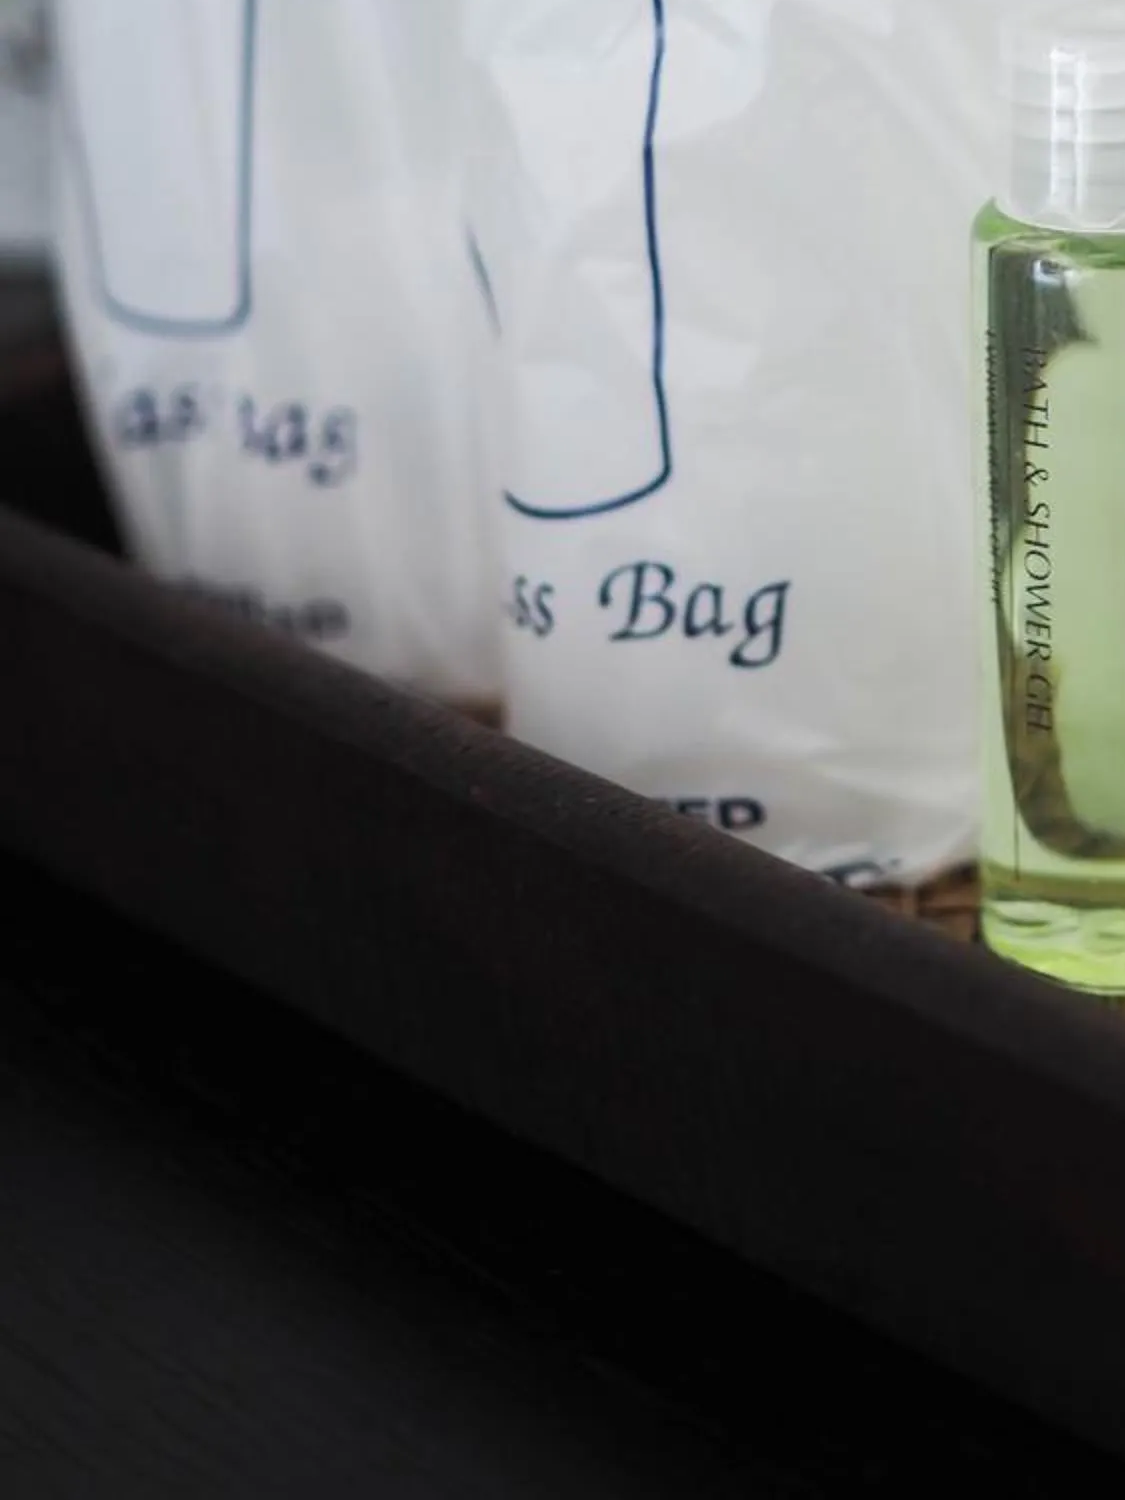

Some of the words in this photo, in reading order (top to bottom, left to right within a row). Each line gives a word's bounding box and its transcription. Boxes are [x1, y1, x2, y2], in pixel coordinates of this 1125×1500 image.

[1021, 345, 1050, 449] BATH
[1022, 461, 1050, 487] &
[500, 574, 556, 638] ss
[598, 559, 793, 670] Bag
[1022, 499, 1053, 662] SHOWER
[1024, 673, 1053, 734] GEL
